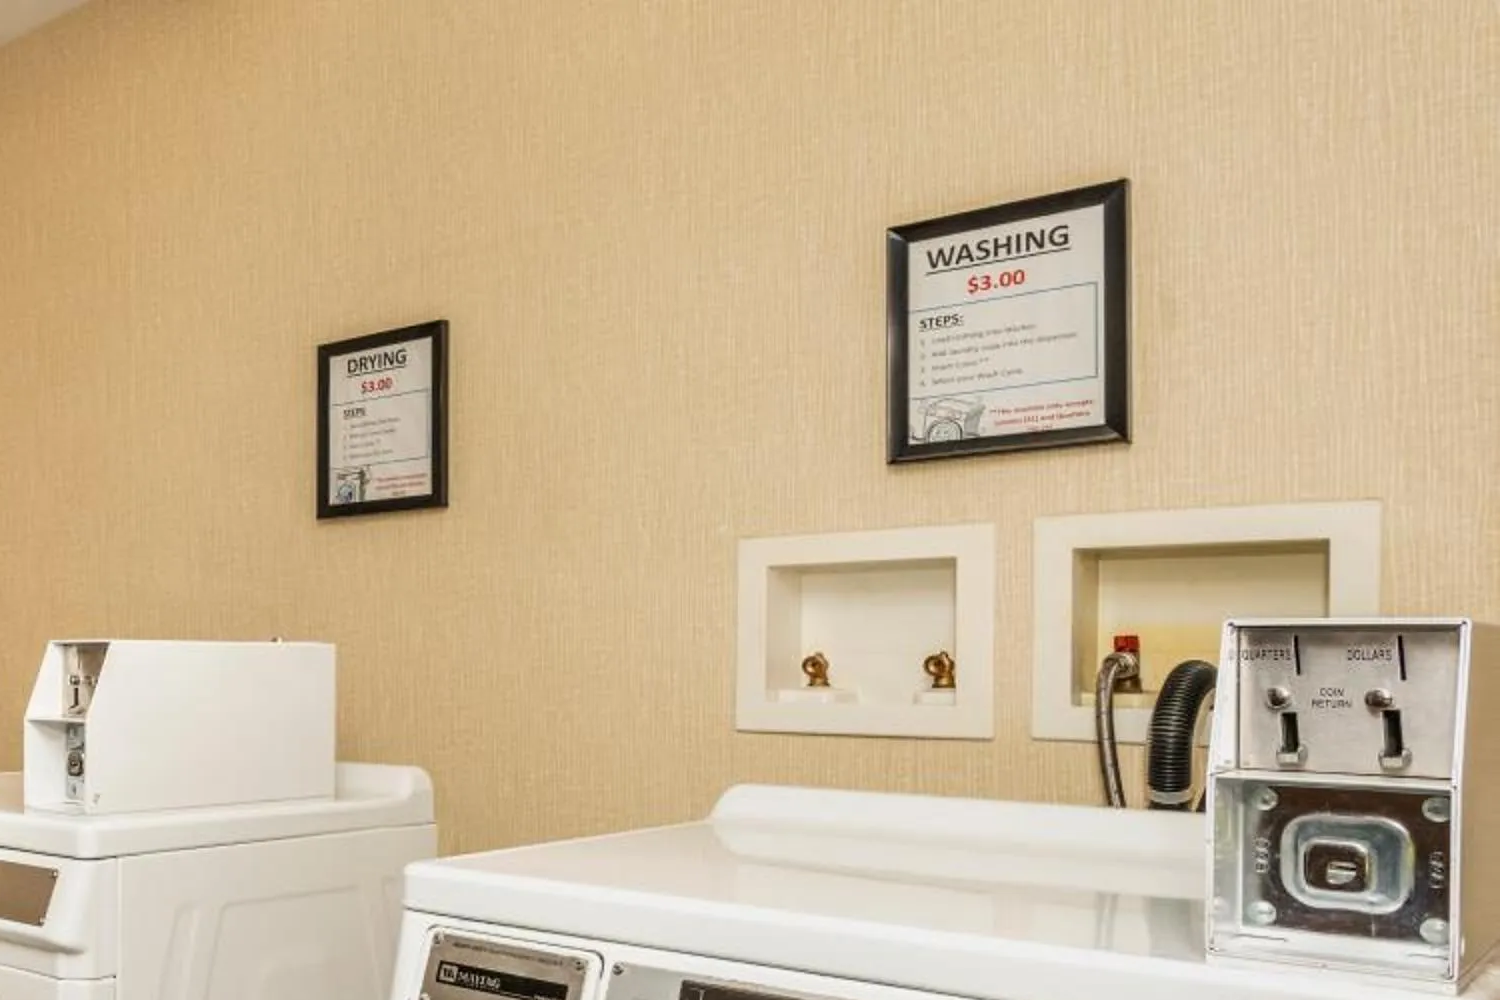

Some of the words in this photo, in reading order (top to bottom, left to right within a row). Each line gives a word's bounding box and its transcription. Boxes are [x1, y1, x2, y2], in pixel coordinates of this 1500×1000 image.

[926, 225, 1070, 269] WASHING
[967, 269, 1025, 294] $3.00
[919, 313, 964, 329] STEPS:
[347, 349, 407, 374] DRYING
[1241, 649, 1291, 661] QUARTERS
[1347, 649, 1392, 662] DOLLARS
[1319, 687, 1344, 697] COIN
[1311, 698, 1351, 709] RETURN
